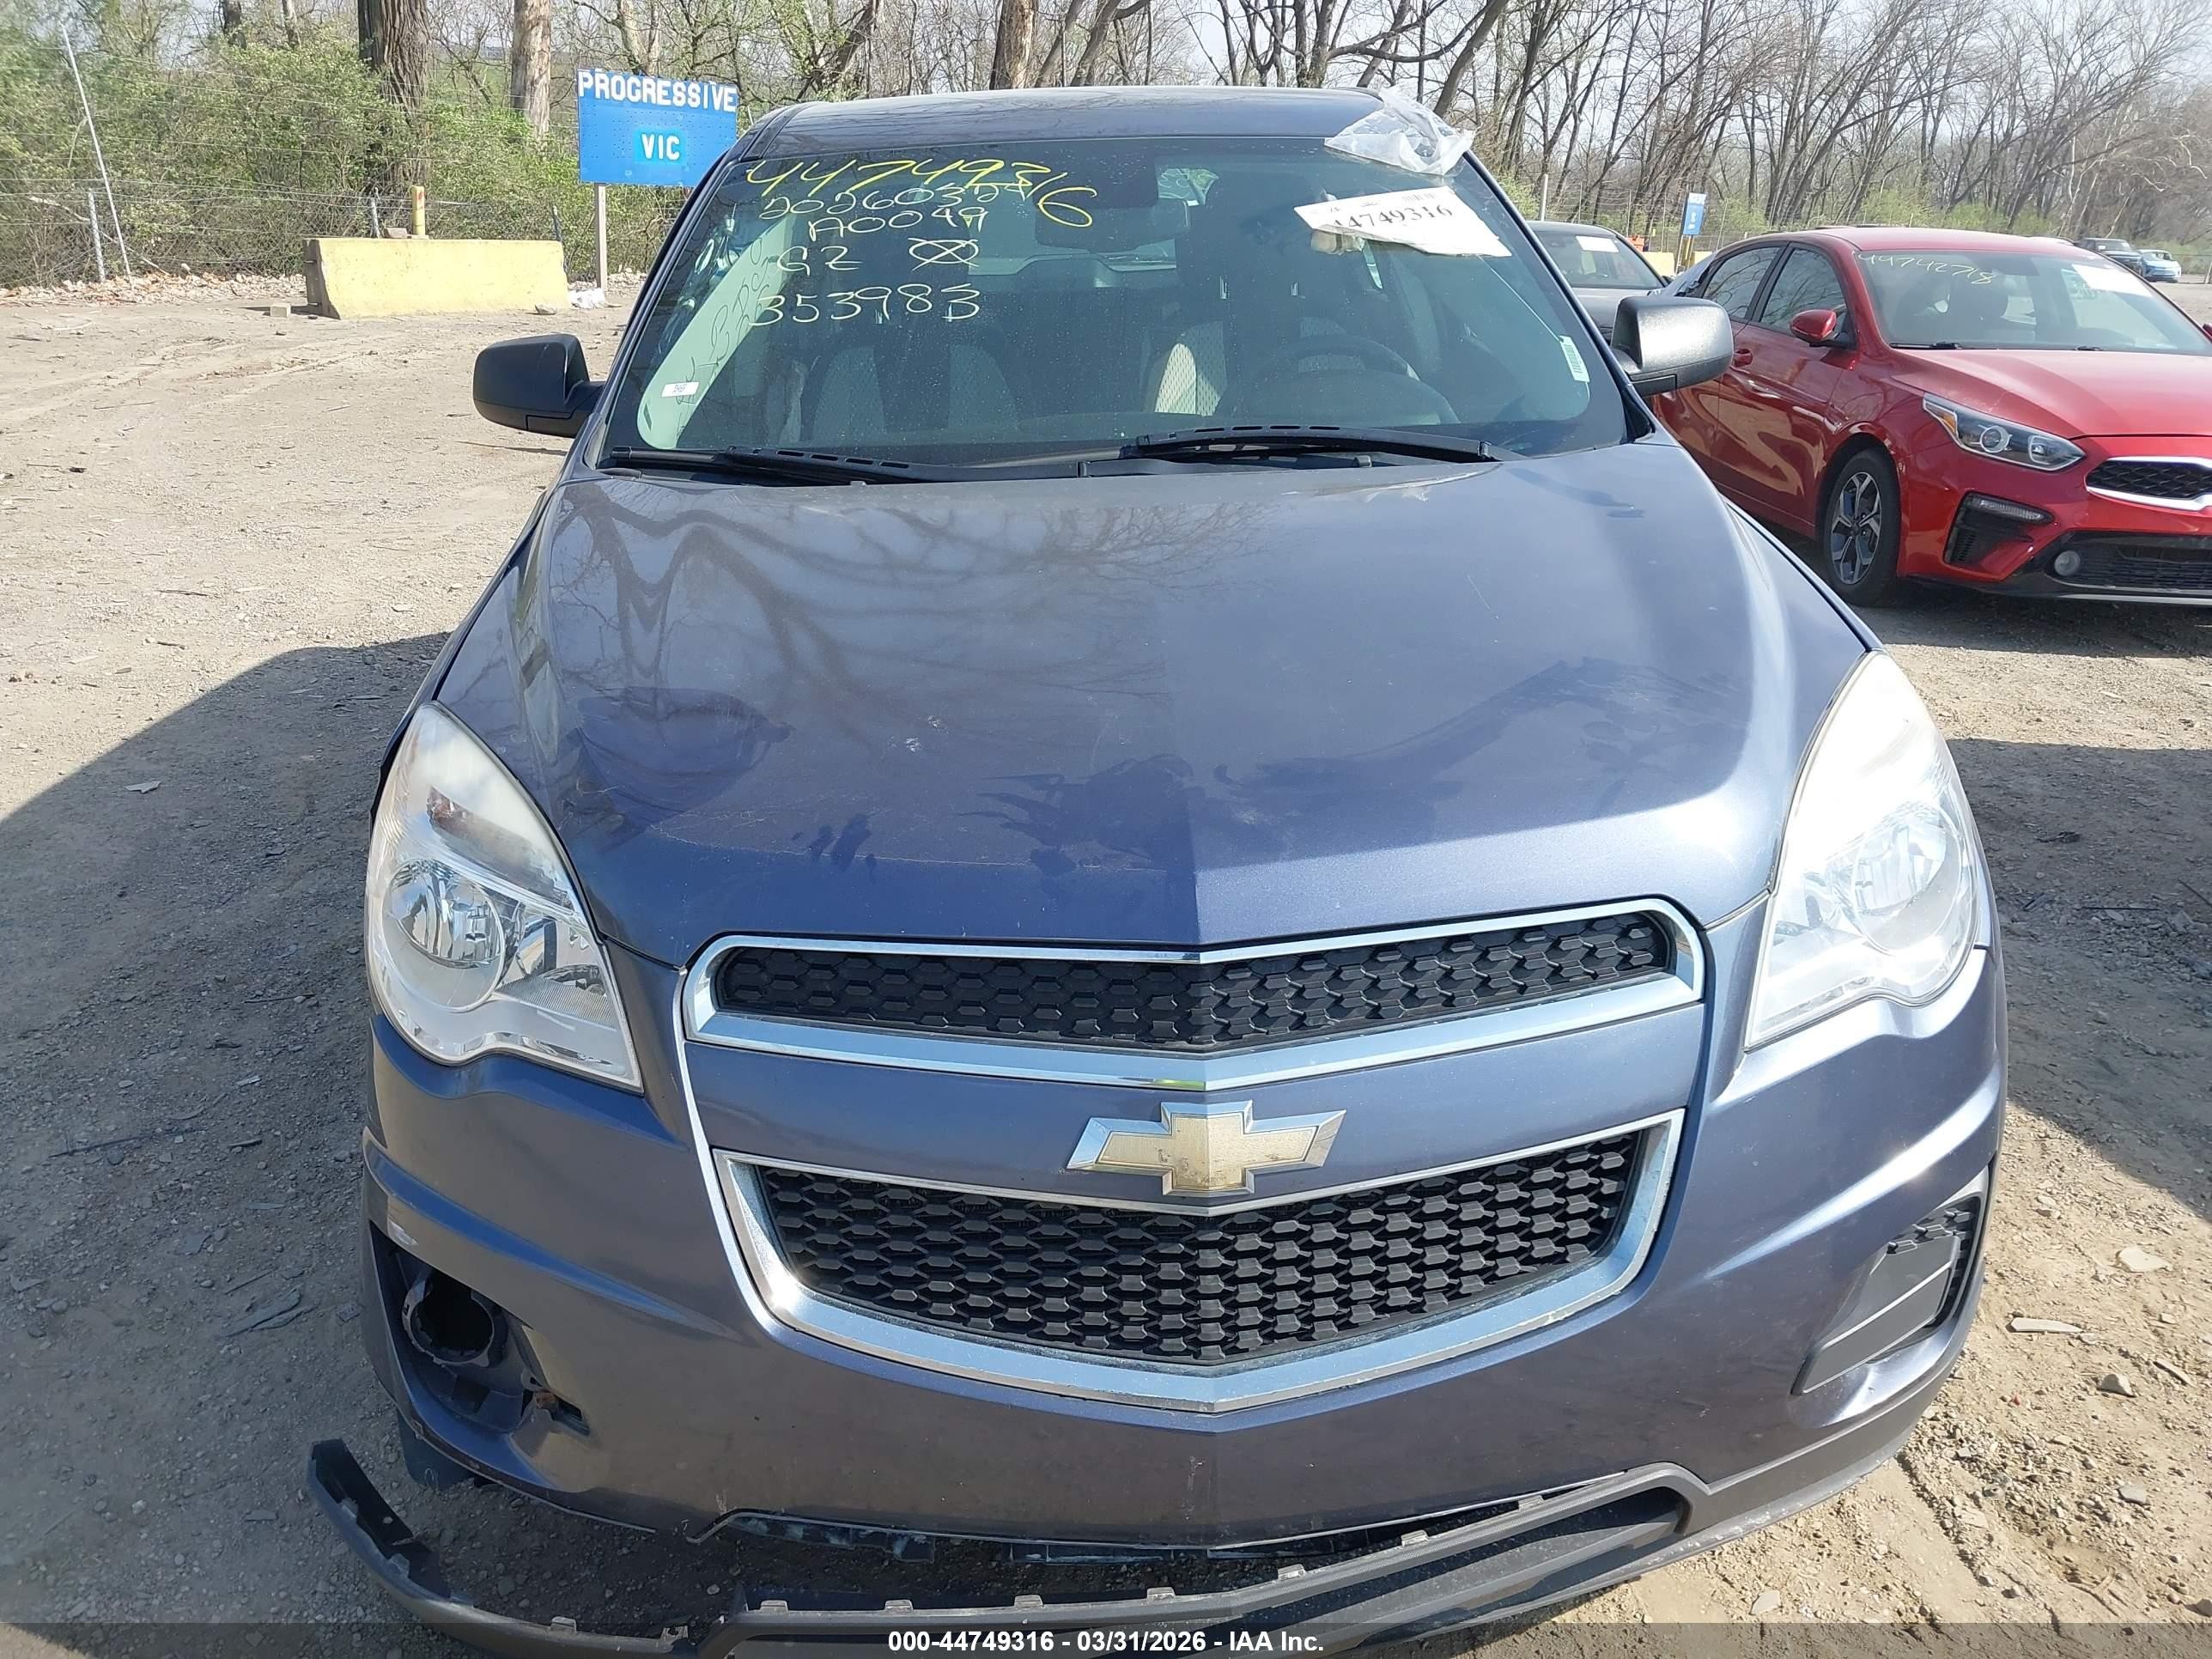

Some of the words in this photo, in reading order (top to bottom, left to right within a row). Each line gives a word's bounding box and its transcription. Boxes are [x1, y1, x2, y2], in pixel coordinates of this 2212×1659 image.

[578, 70, 737, 112] PROGRESSIVE
[641, 133, 680, 160] VIC
[808, 206, 988, 242] A0049
[749, 283, 981, 326] 353983
